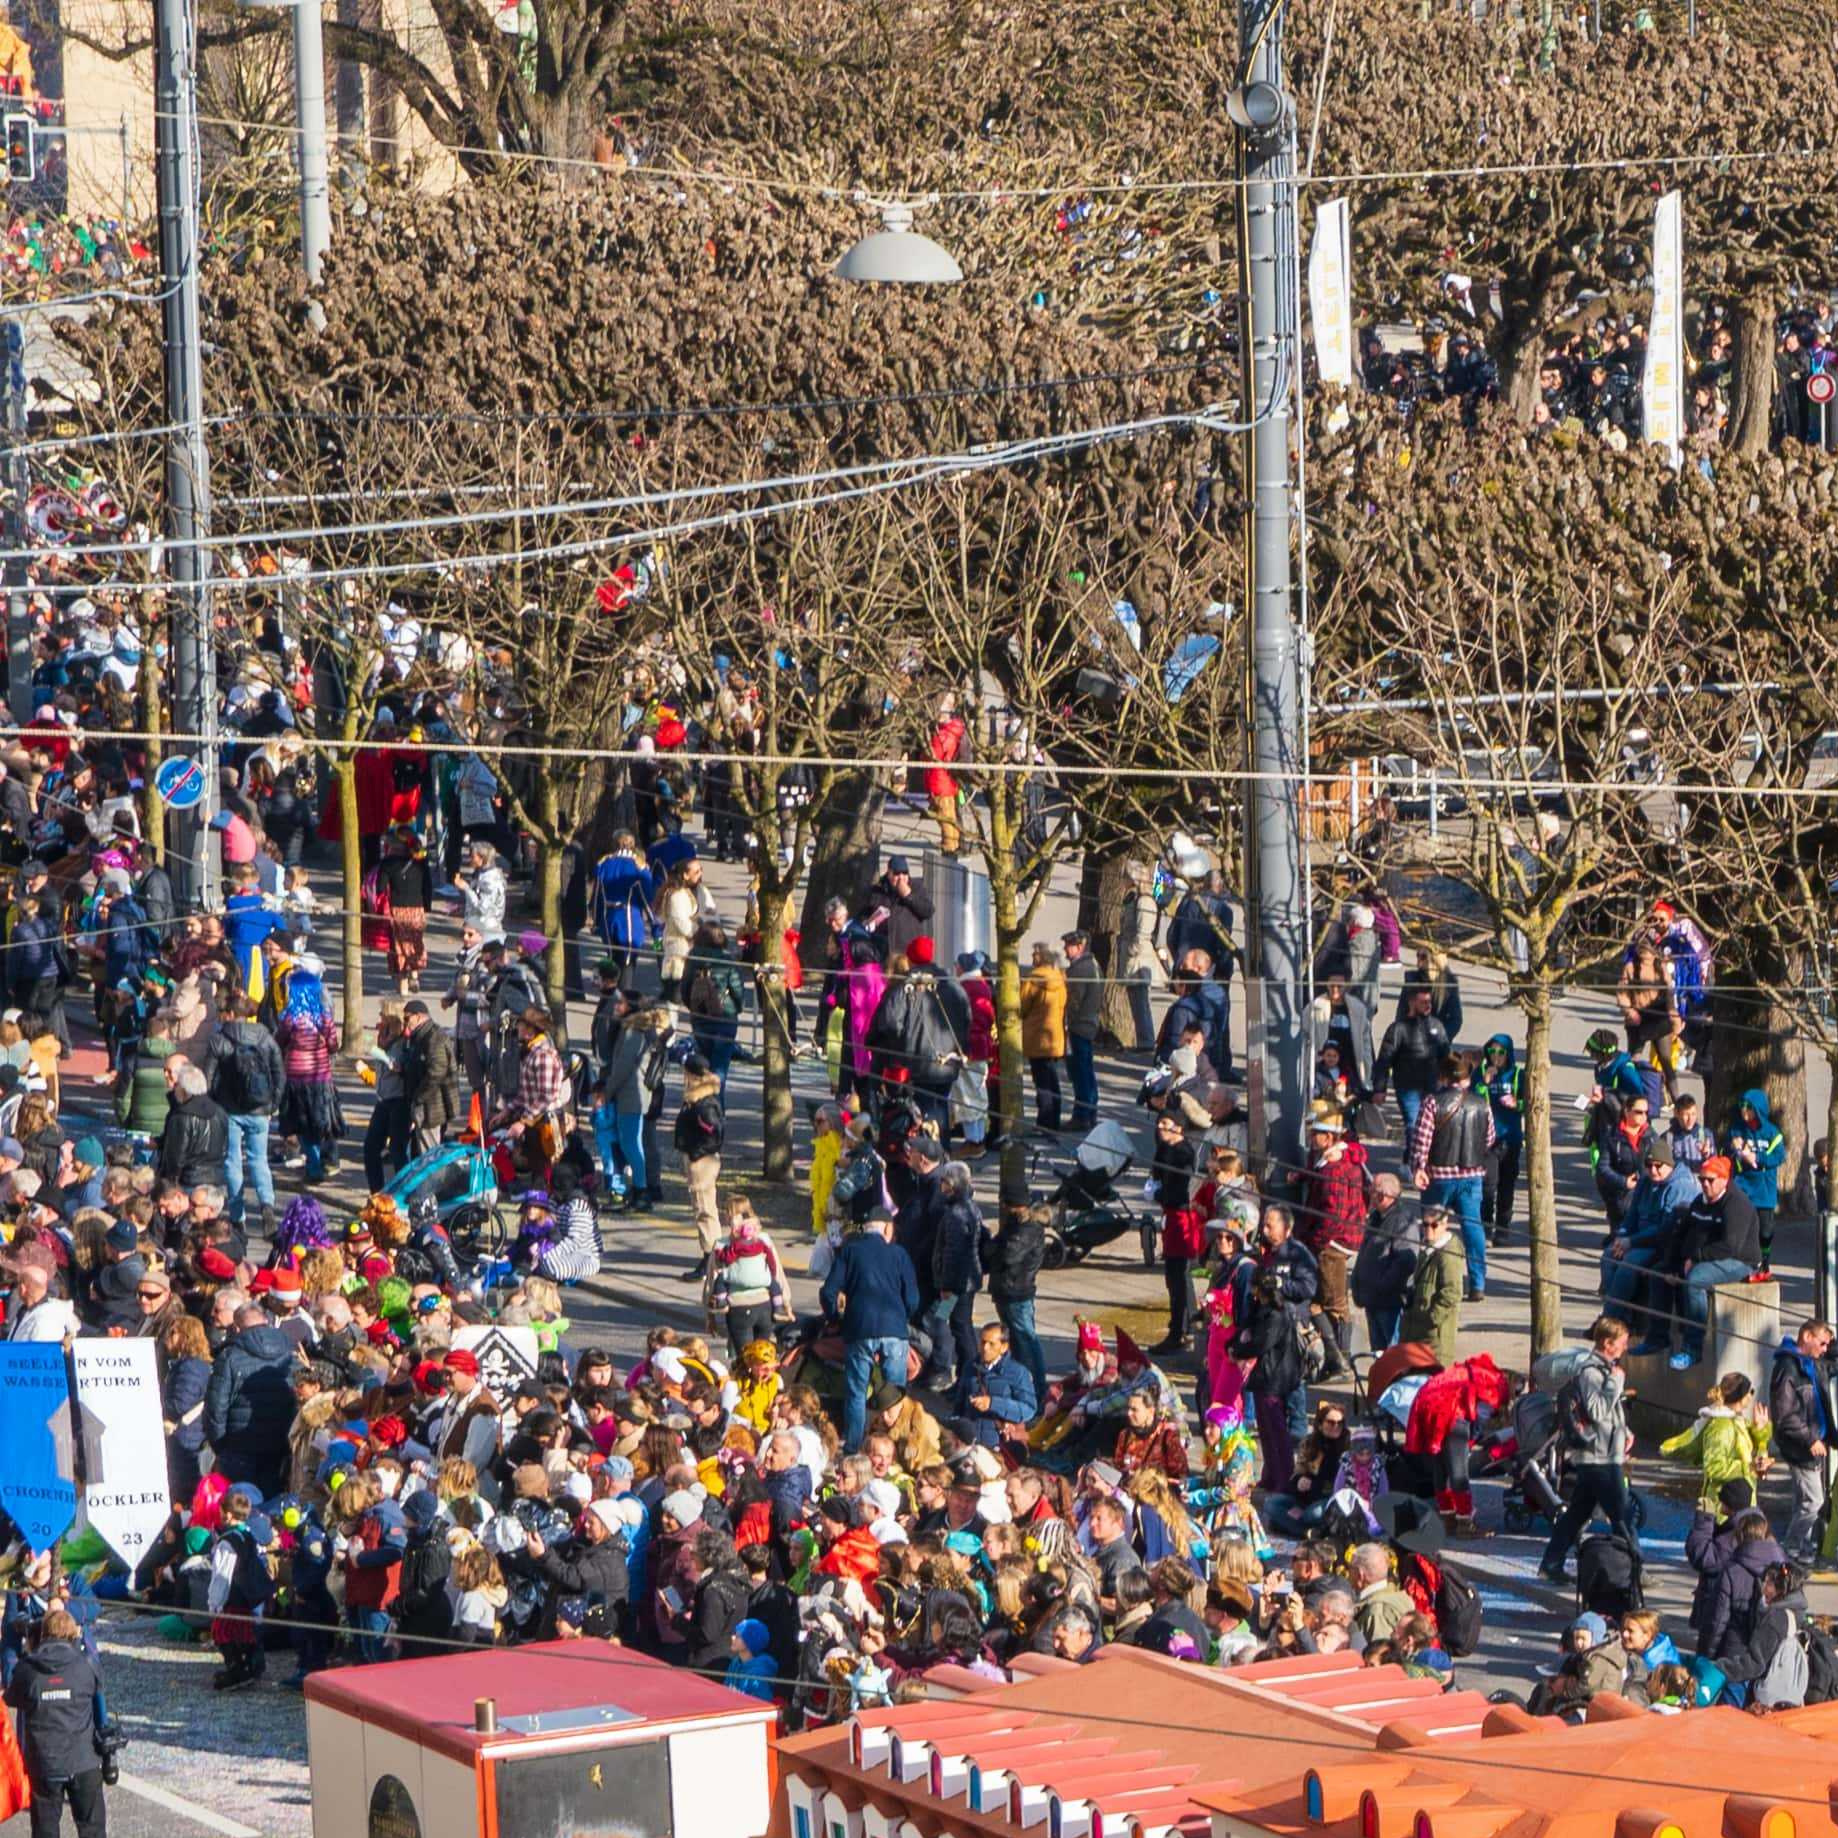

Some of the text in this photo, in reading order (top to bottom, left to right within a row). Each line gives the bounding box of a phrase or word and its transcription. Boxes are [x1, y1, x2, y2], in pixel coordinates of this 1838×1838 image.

[95, 1356, 132, 1368] VOM
[31, 1522, 144, 1545] 20 23
